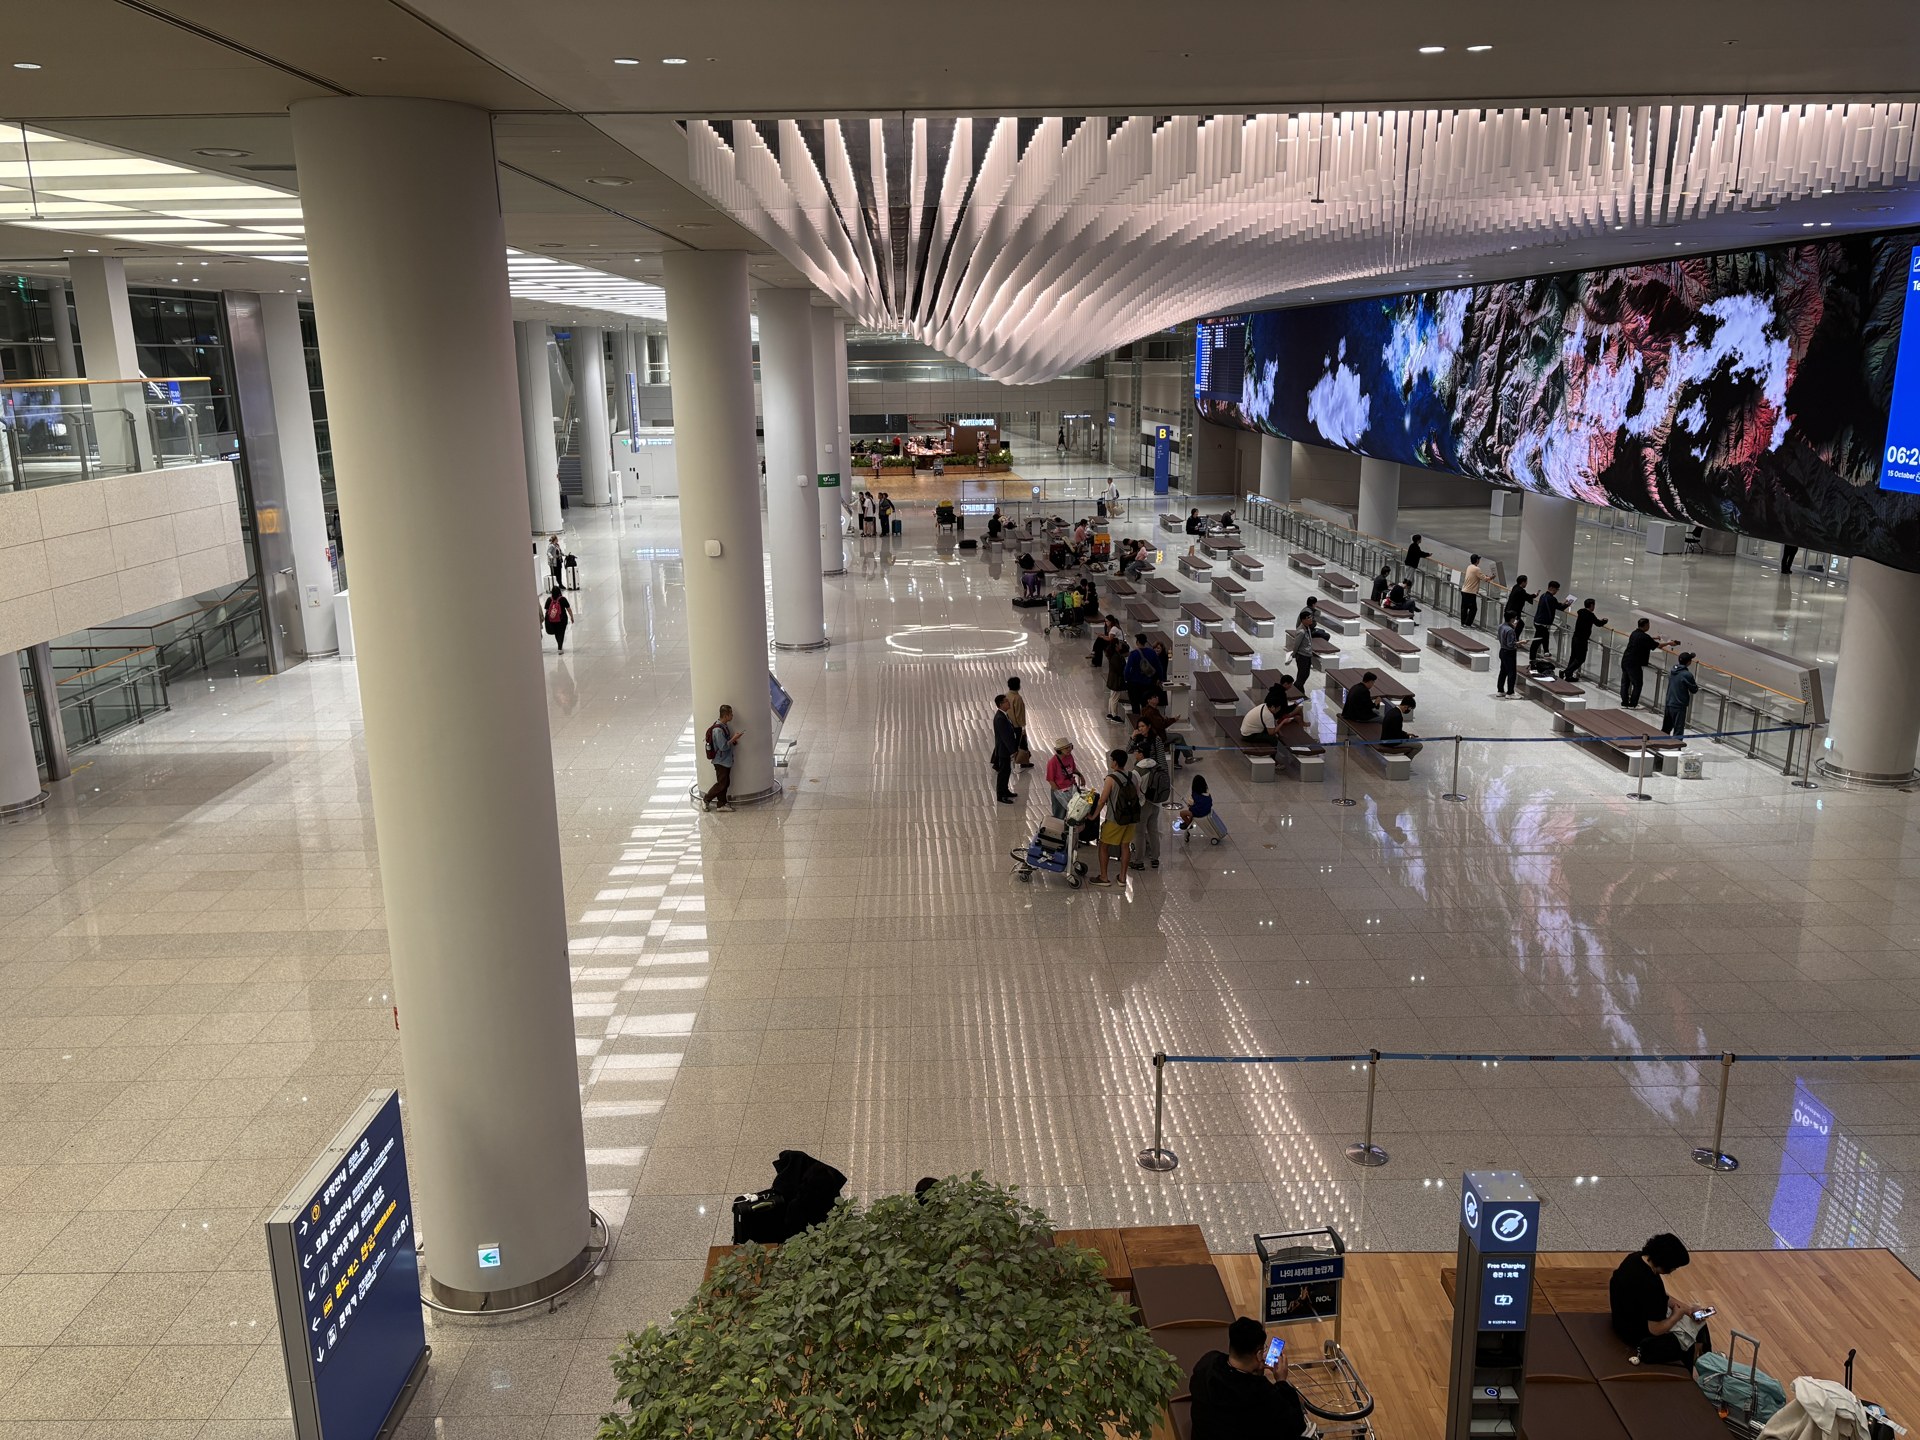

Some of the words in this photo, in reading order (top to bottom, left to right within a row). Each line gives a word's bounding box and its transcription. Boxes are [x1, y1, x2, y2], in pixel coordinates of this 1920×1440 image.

[1159, 428, 1167, 439] B
[1886, 445, 1920, 466] 06:2
[1887, 469, 1895, 477] 15
[1894, 470, 1916, 480] October
[323, 1167, 347, 1206] 공항안내
[1280, 1270, 1293, 1278] 나의
[1294, 1267, 1313, 1276] 세계를
